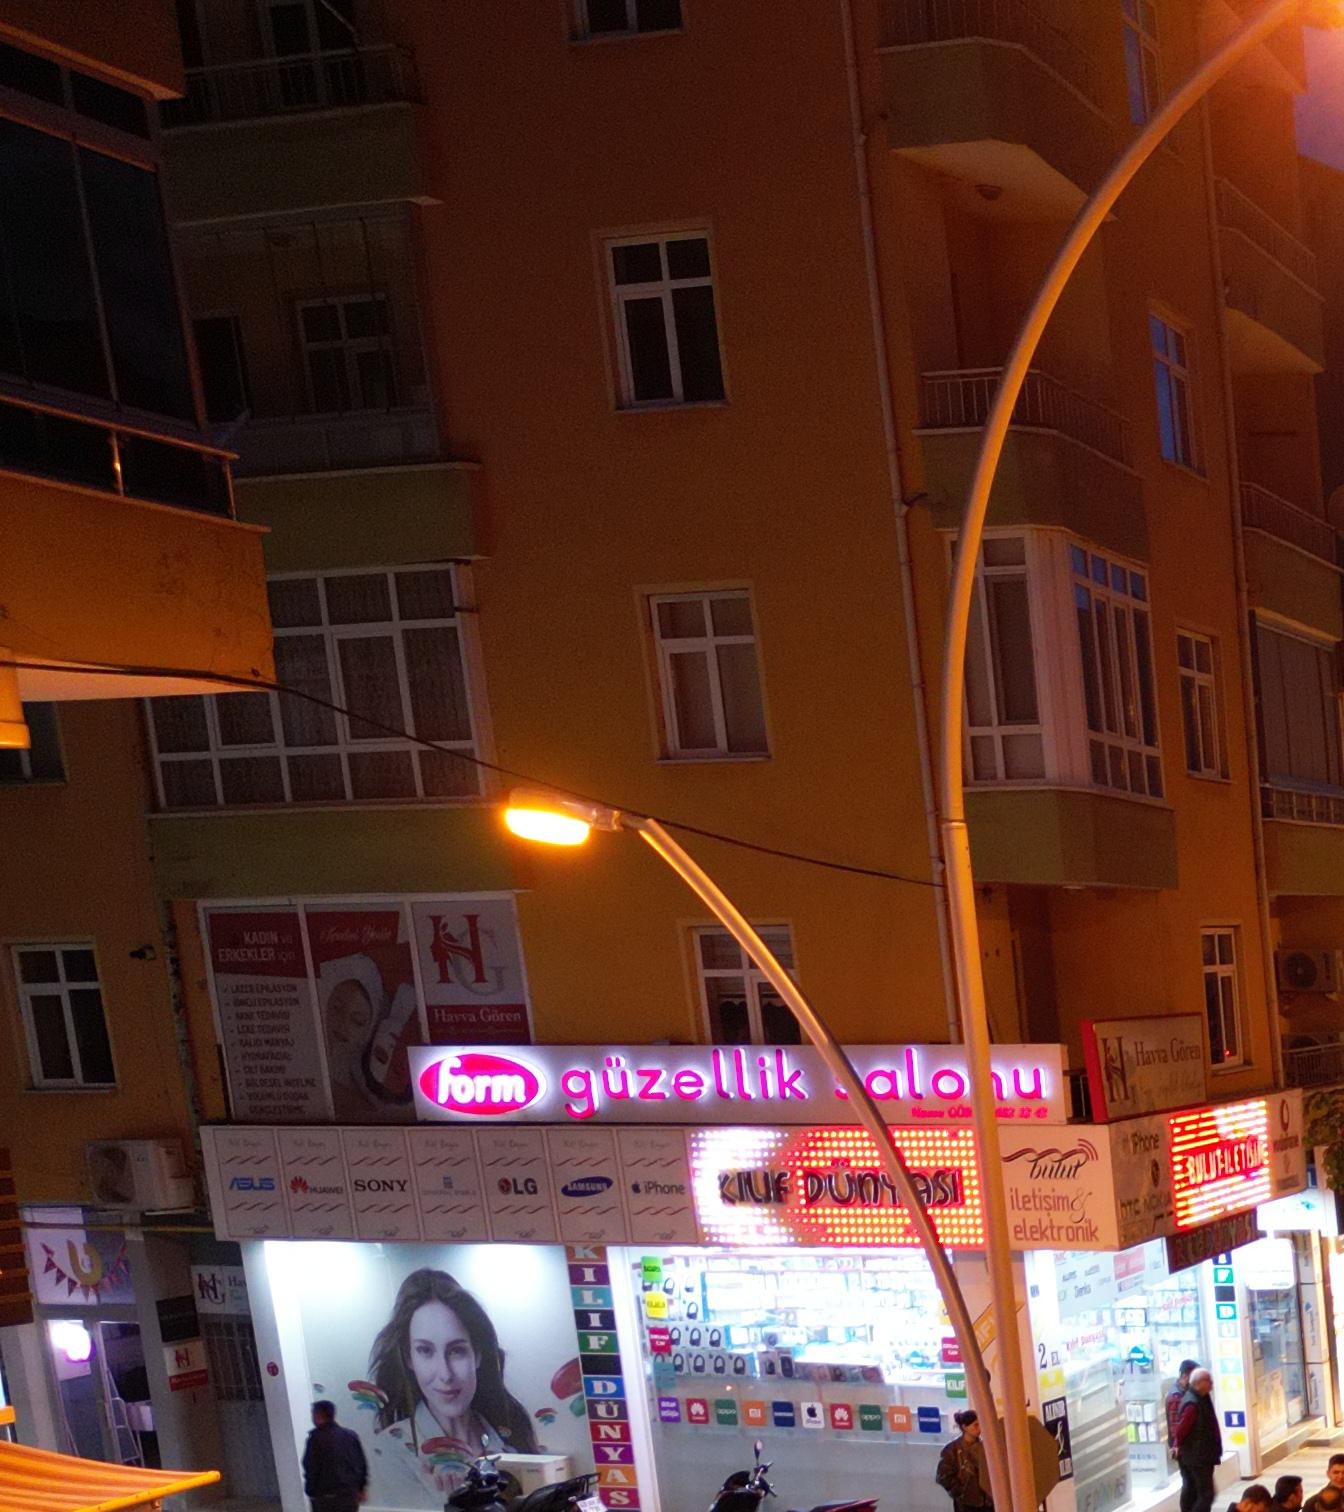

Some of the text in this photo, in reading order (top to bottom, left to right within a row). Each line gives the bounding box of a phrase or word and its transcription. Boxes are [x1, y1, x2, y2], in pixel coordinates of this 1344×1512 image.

[243, 931, 278, 944] KADIN
[218, 947, 276, 963] ERKEKLER
[433, 1007, 522, 1024] Havva Gören
[1134, 1041, 1169, 1067] Havva
[437, 1056, 527, 1106] form
[561, 1049, 808, 1119] güzellik
[1027, 1154, 1089, 1180] bulut
[229, 1177, 276, 1191] ASUS
[309, 1185, 344, 1195] HUAWEI
[354, 1179, 408, 1193] SONY
[512, 1178, 538, 1196] LG
[644, 1181, 686, 1196] iPhone
[718, 1161, 962, 1206] KILIF DÜNYASI
[1009, 1187, 1070, 1216] iletişim
[1013, 1217, 1100, 1242] elektronik
